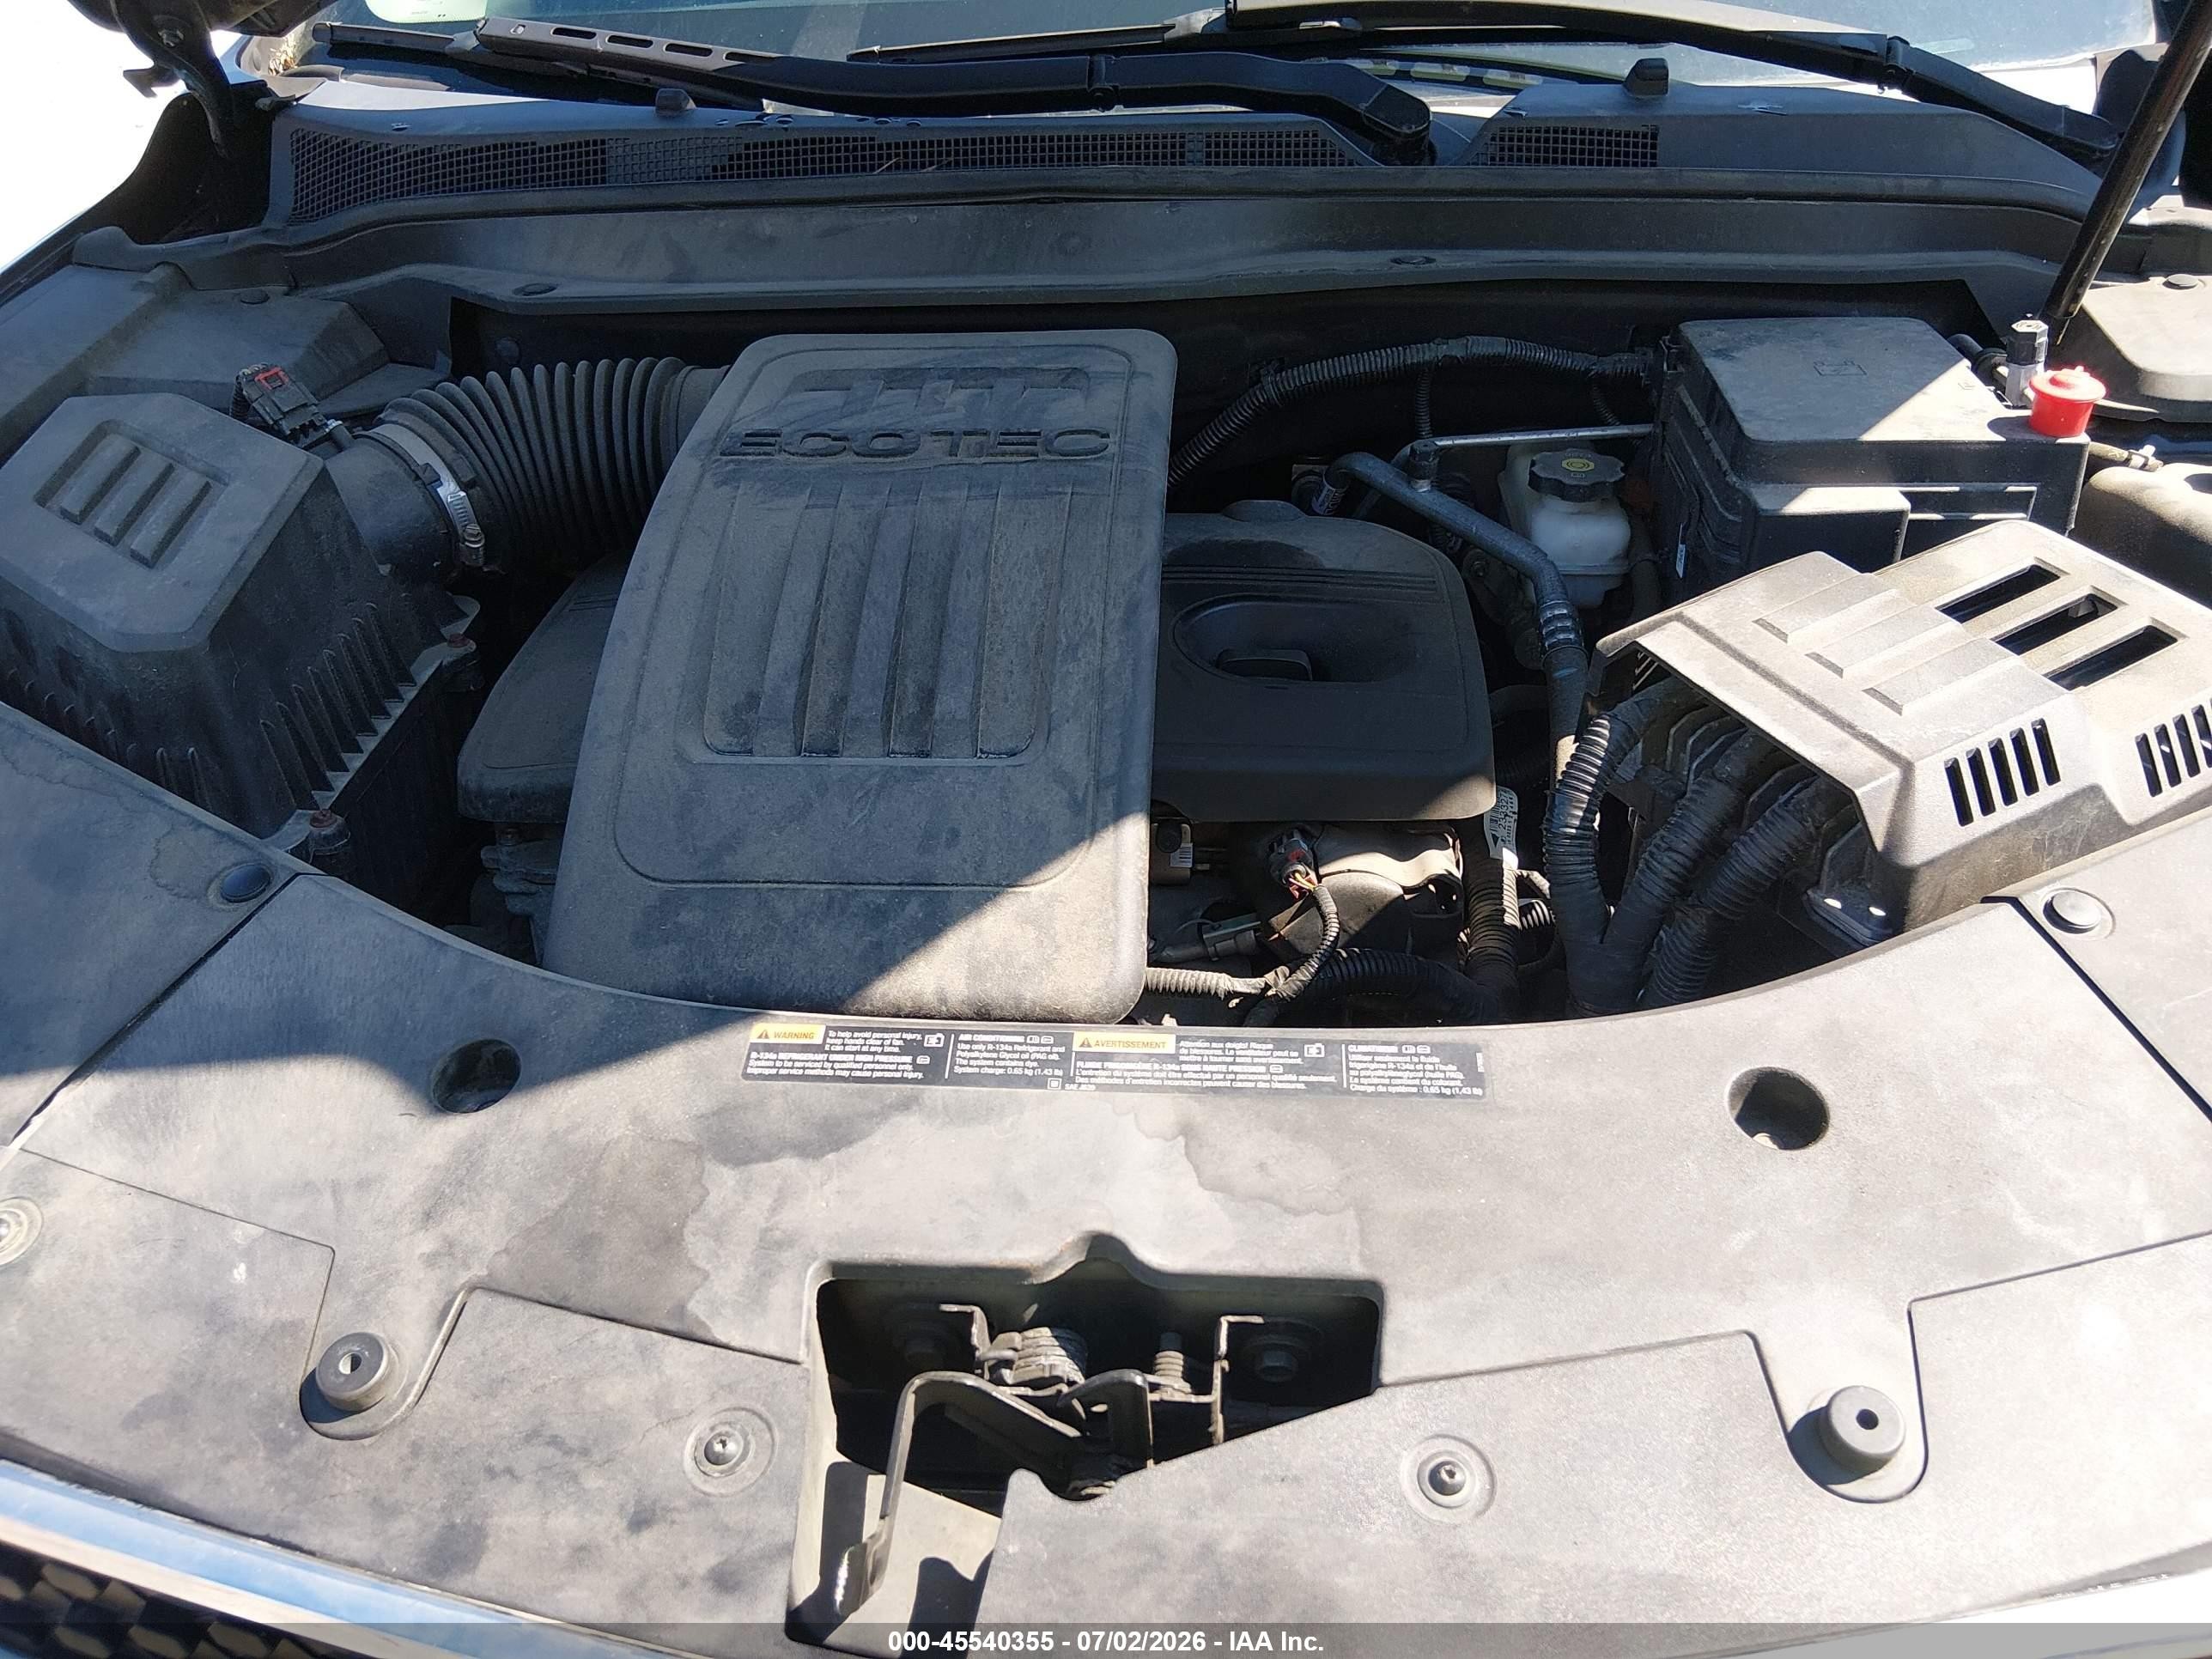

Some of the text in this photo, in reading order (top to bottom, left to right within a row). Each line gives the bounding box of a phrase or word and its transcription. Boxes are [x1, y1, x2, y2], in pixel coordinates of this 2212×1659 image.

[720, 428, 1112, 459] ECOTEC
[774, 1031, 814, 1039] WARNING
[1094, 1040, 1167, 1048] AVERTISSEMENT
